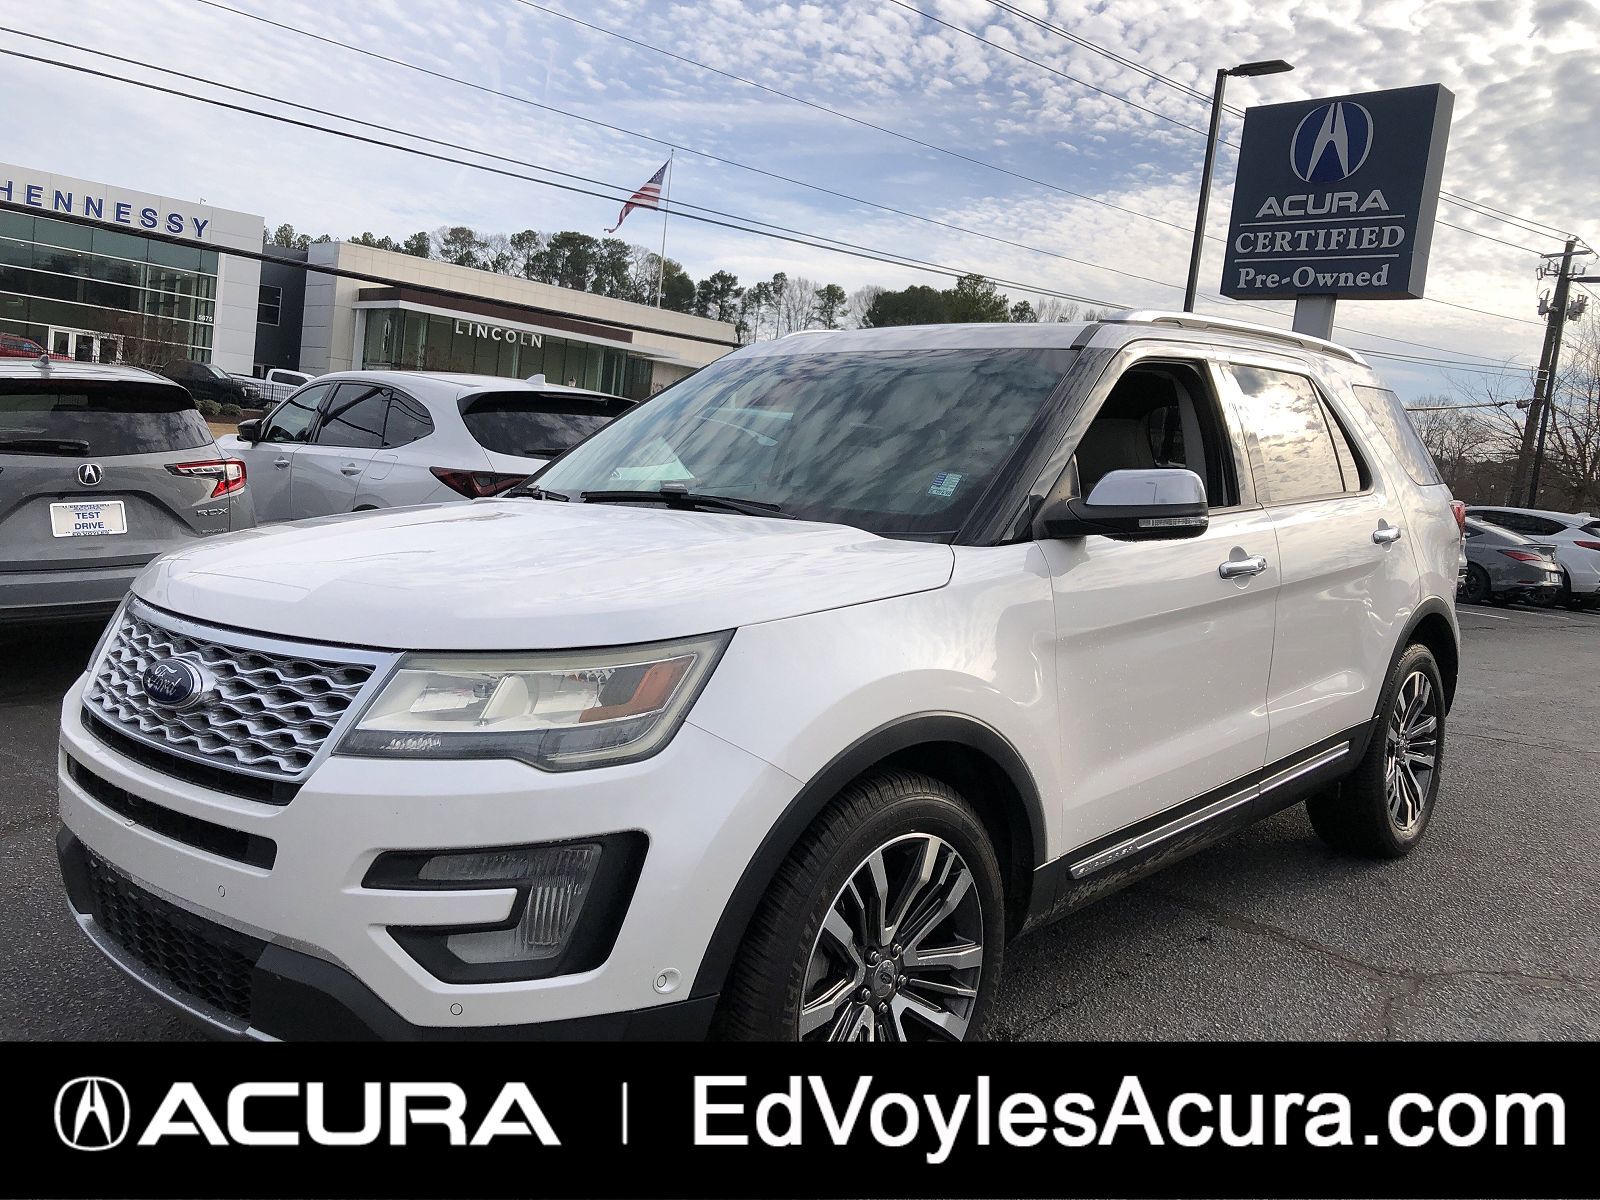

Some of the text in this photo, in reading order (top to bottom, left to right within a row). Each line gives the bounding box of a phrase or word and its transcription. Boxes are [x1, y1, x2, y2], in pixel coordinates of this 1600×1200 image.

[0, 179, 209, 238] HENNESSY
[1255, 189, 1389, 218] ACURA
[1234, 225, 1406, 254] CERTIFIED
[1236, 263, 1390, 289] Pre-Owned
[455, 320, 543, 348] LINCOLN
[74, 521, 105, 530] DRIVE
[75, 511, 101, 520] TEST
[147, 664, 182, 697] Ford
